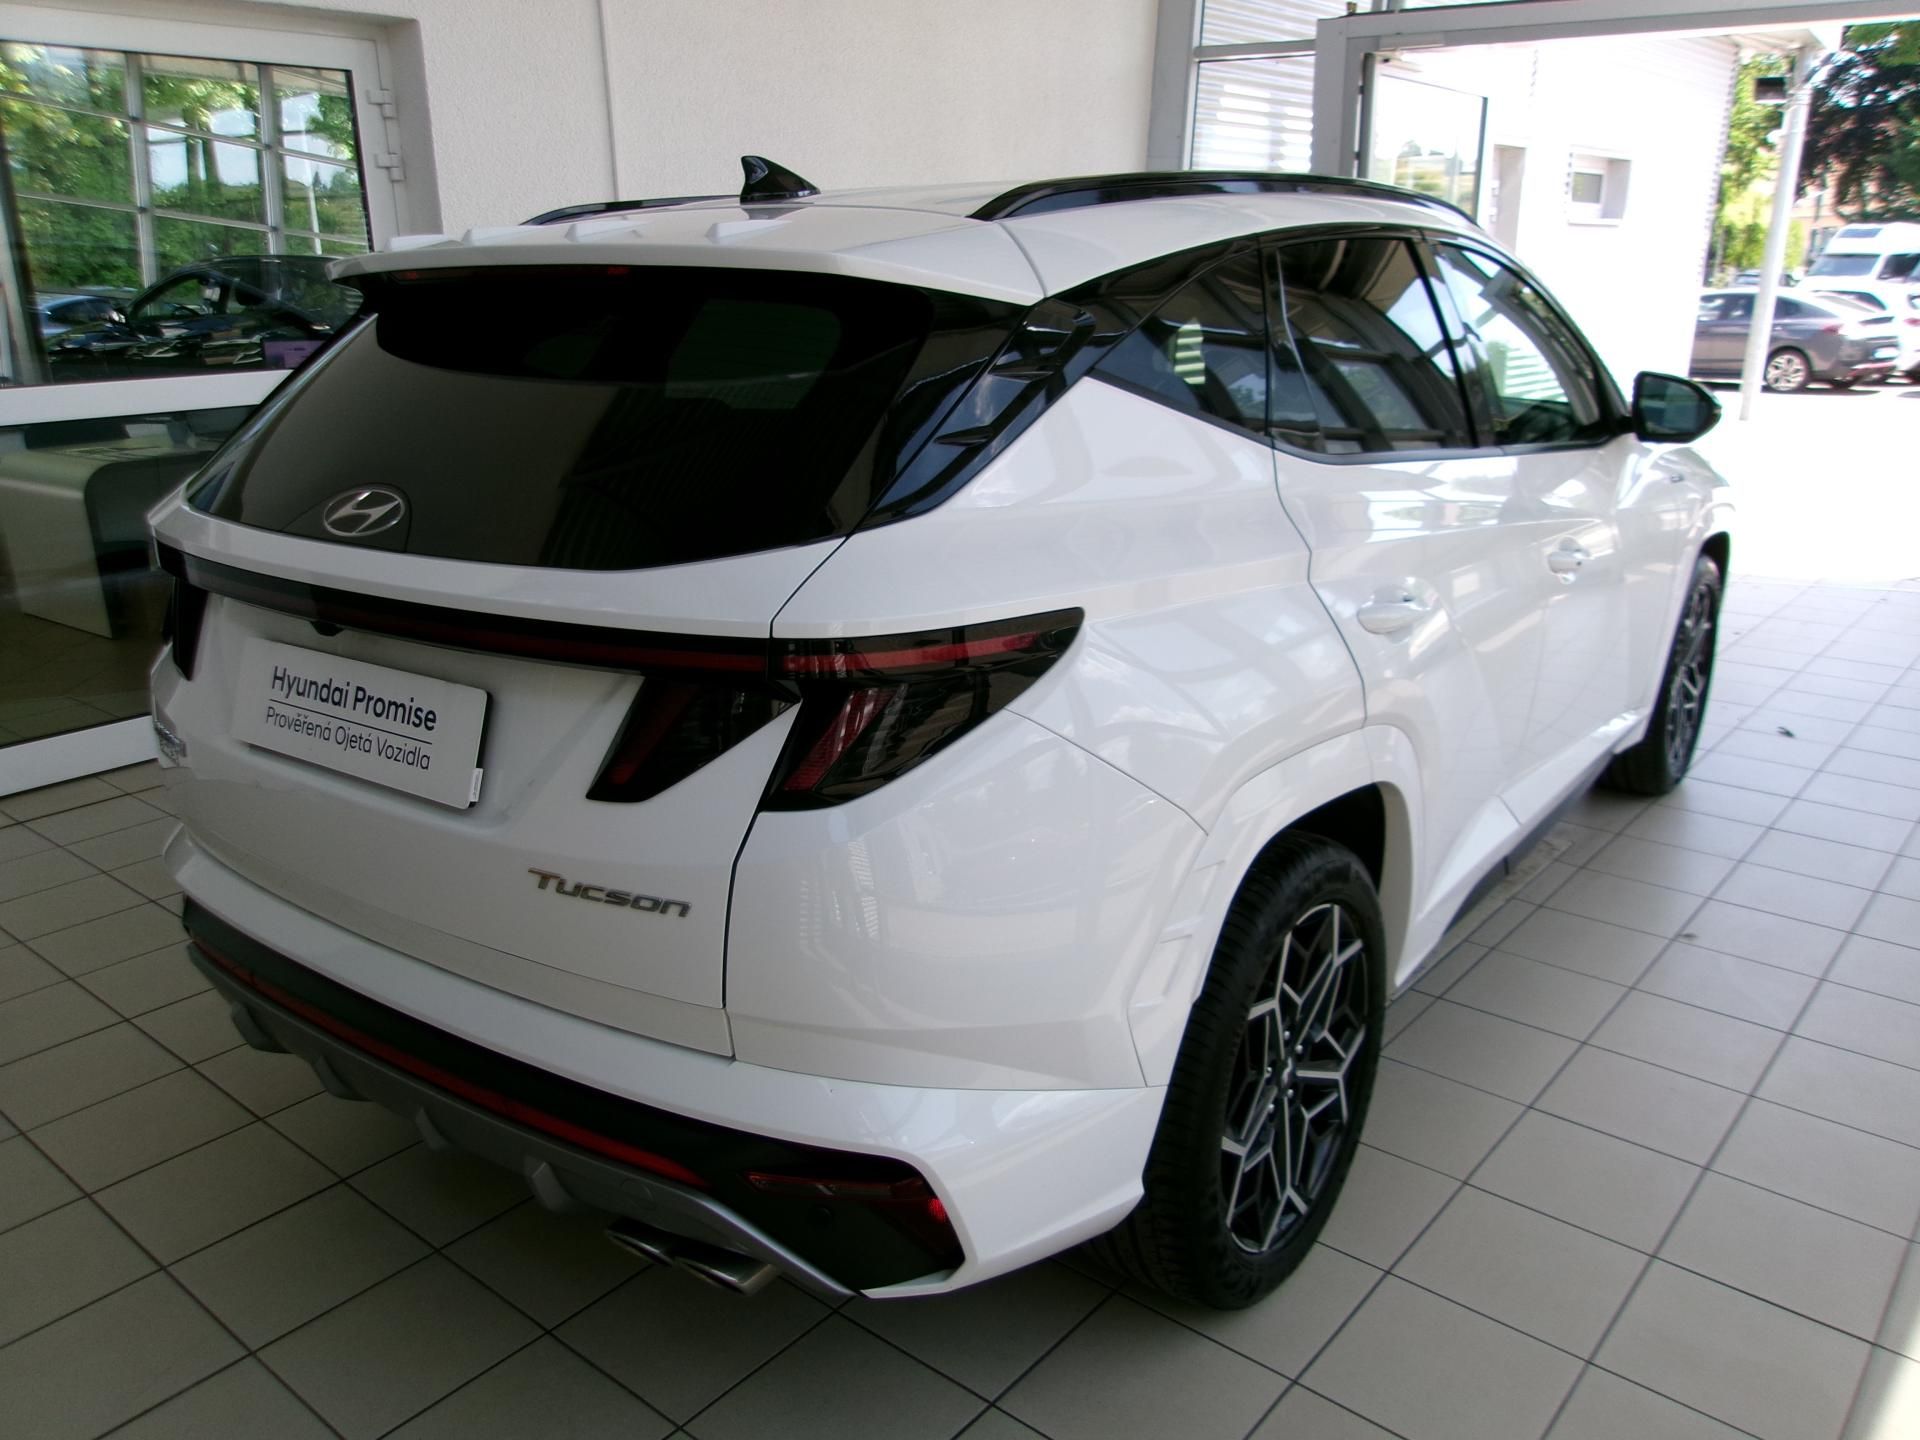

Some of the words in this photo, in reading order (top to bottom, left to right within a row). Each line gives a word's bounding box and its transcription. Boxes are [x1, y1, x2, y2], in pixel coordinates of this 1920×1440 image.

[271, 665, 350, 708] Hyundai
[353, 685, 436, 730] Promise
[265, 706, 331, 741] Prověřená
[334, 725, 373, 753] Ojetá
[377, 736, 430, 770] Vozidla
